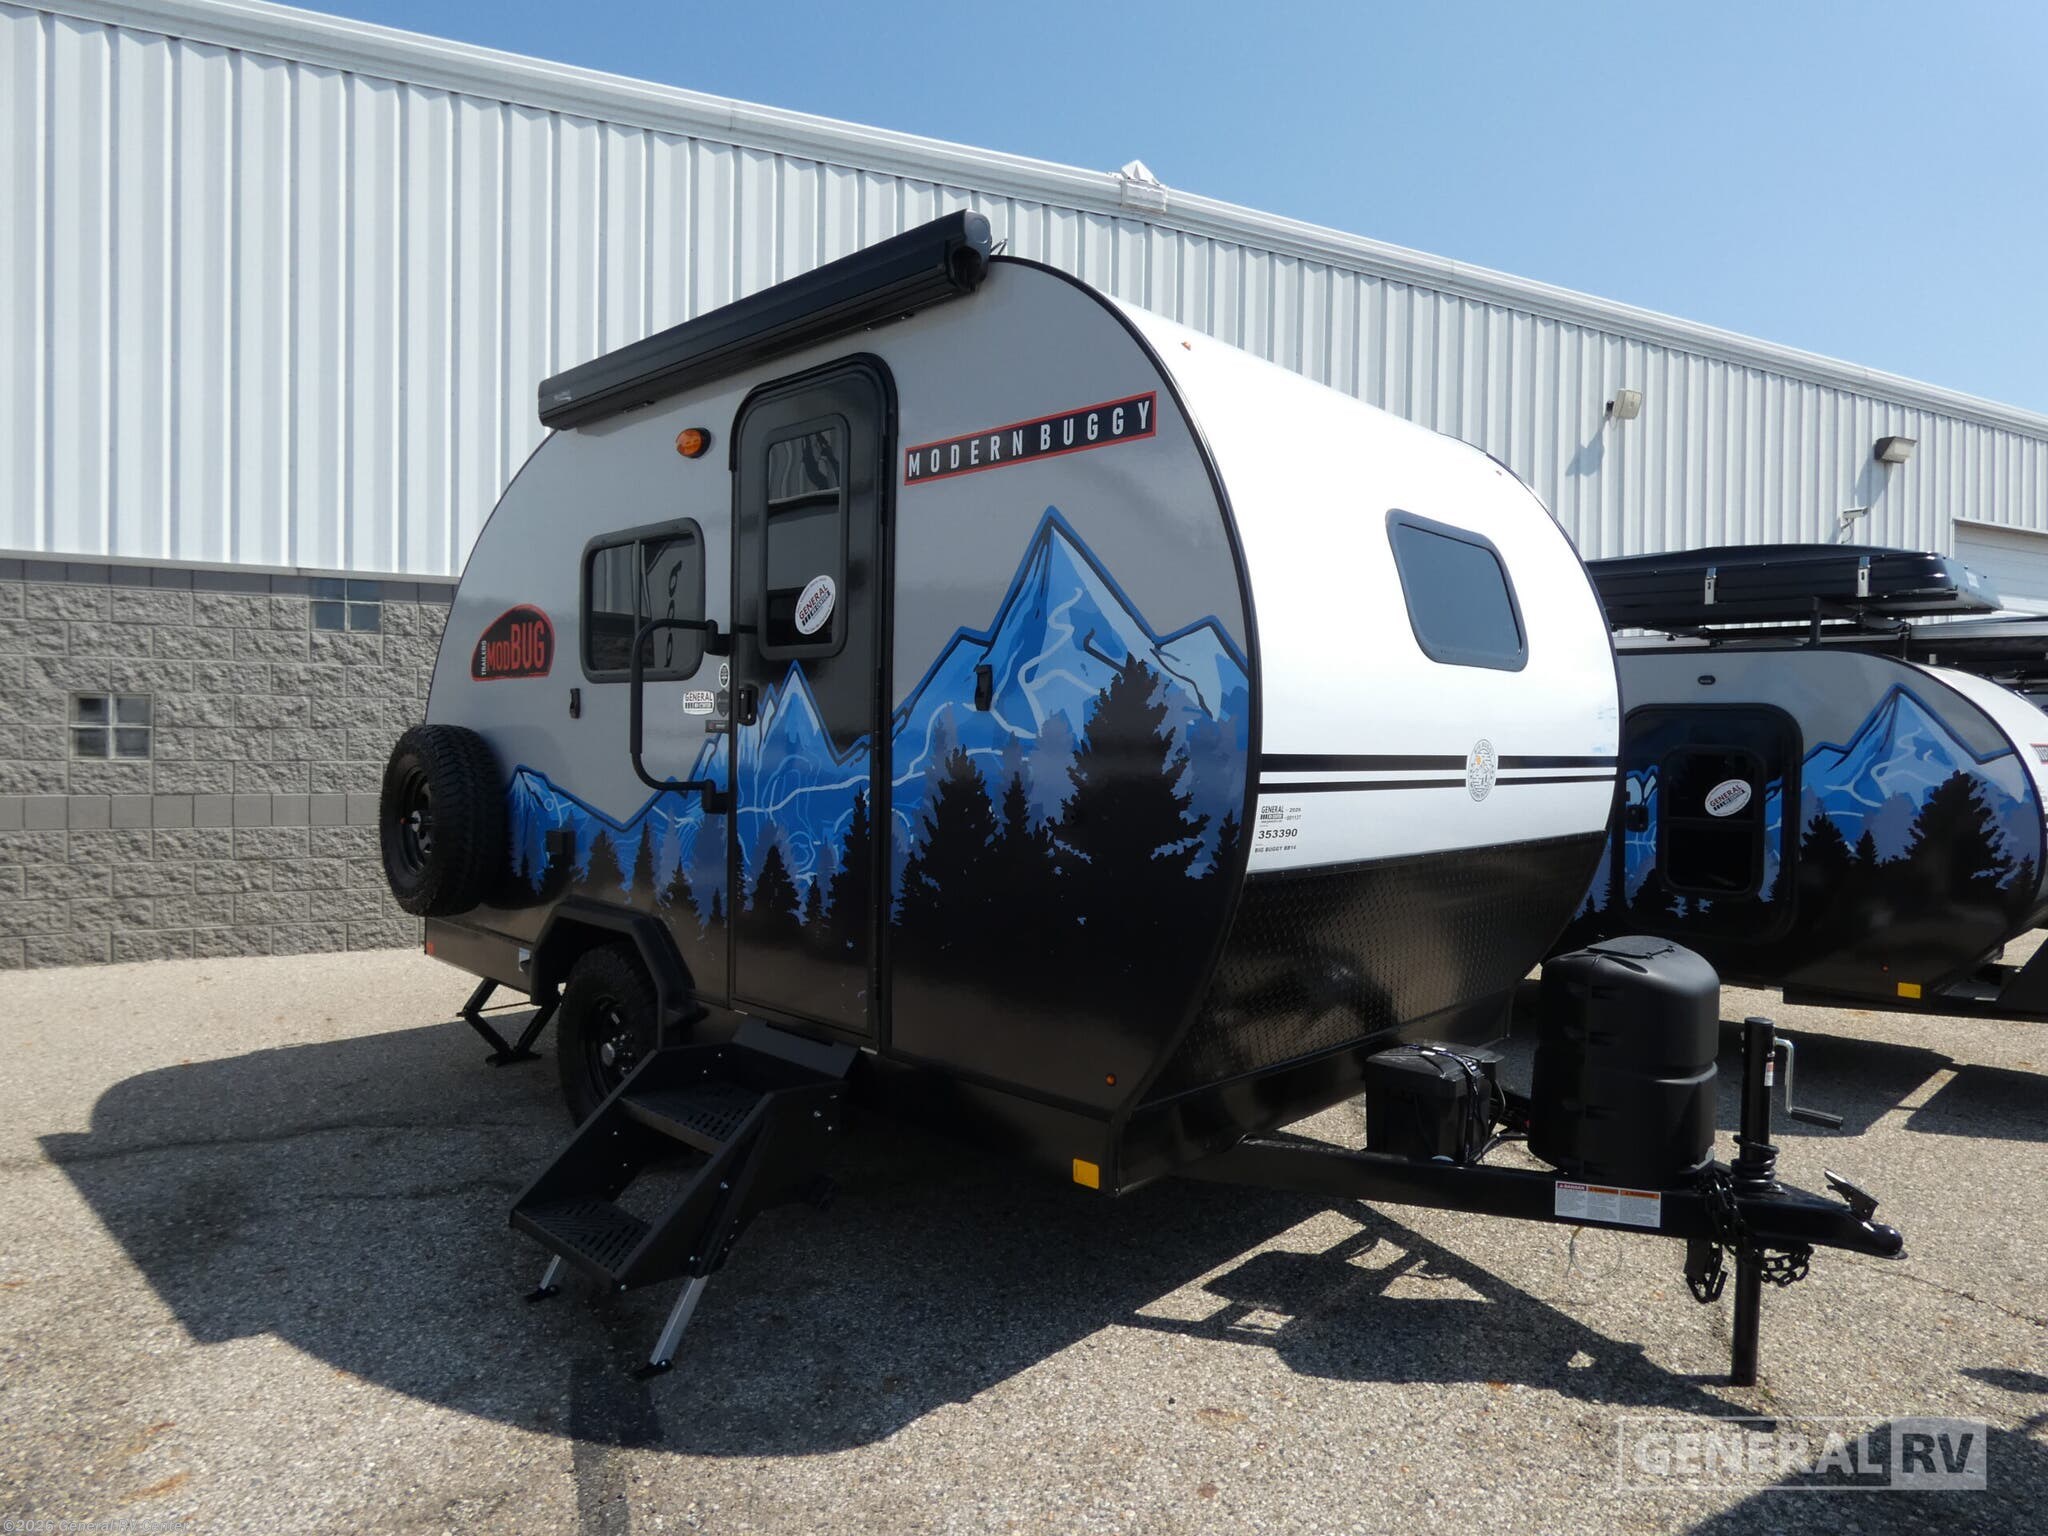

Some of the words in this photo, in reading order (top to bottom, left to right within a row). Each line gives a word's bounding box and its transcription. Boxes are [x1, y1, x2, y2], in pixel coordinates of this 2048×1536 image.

[908, 430, 1023, 477] MODERN
[1040, 401, 1150, 450] BUGGY
[799, 584, 828, 620] GENERAL
[685, 692, 713, 702] GENERAL
[1710, 785, 1743, 807] GENERAL
[1261, 805, 1284, 814] GENERAL
[1258, 828, 1298, 839] 353390
